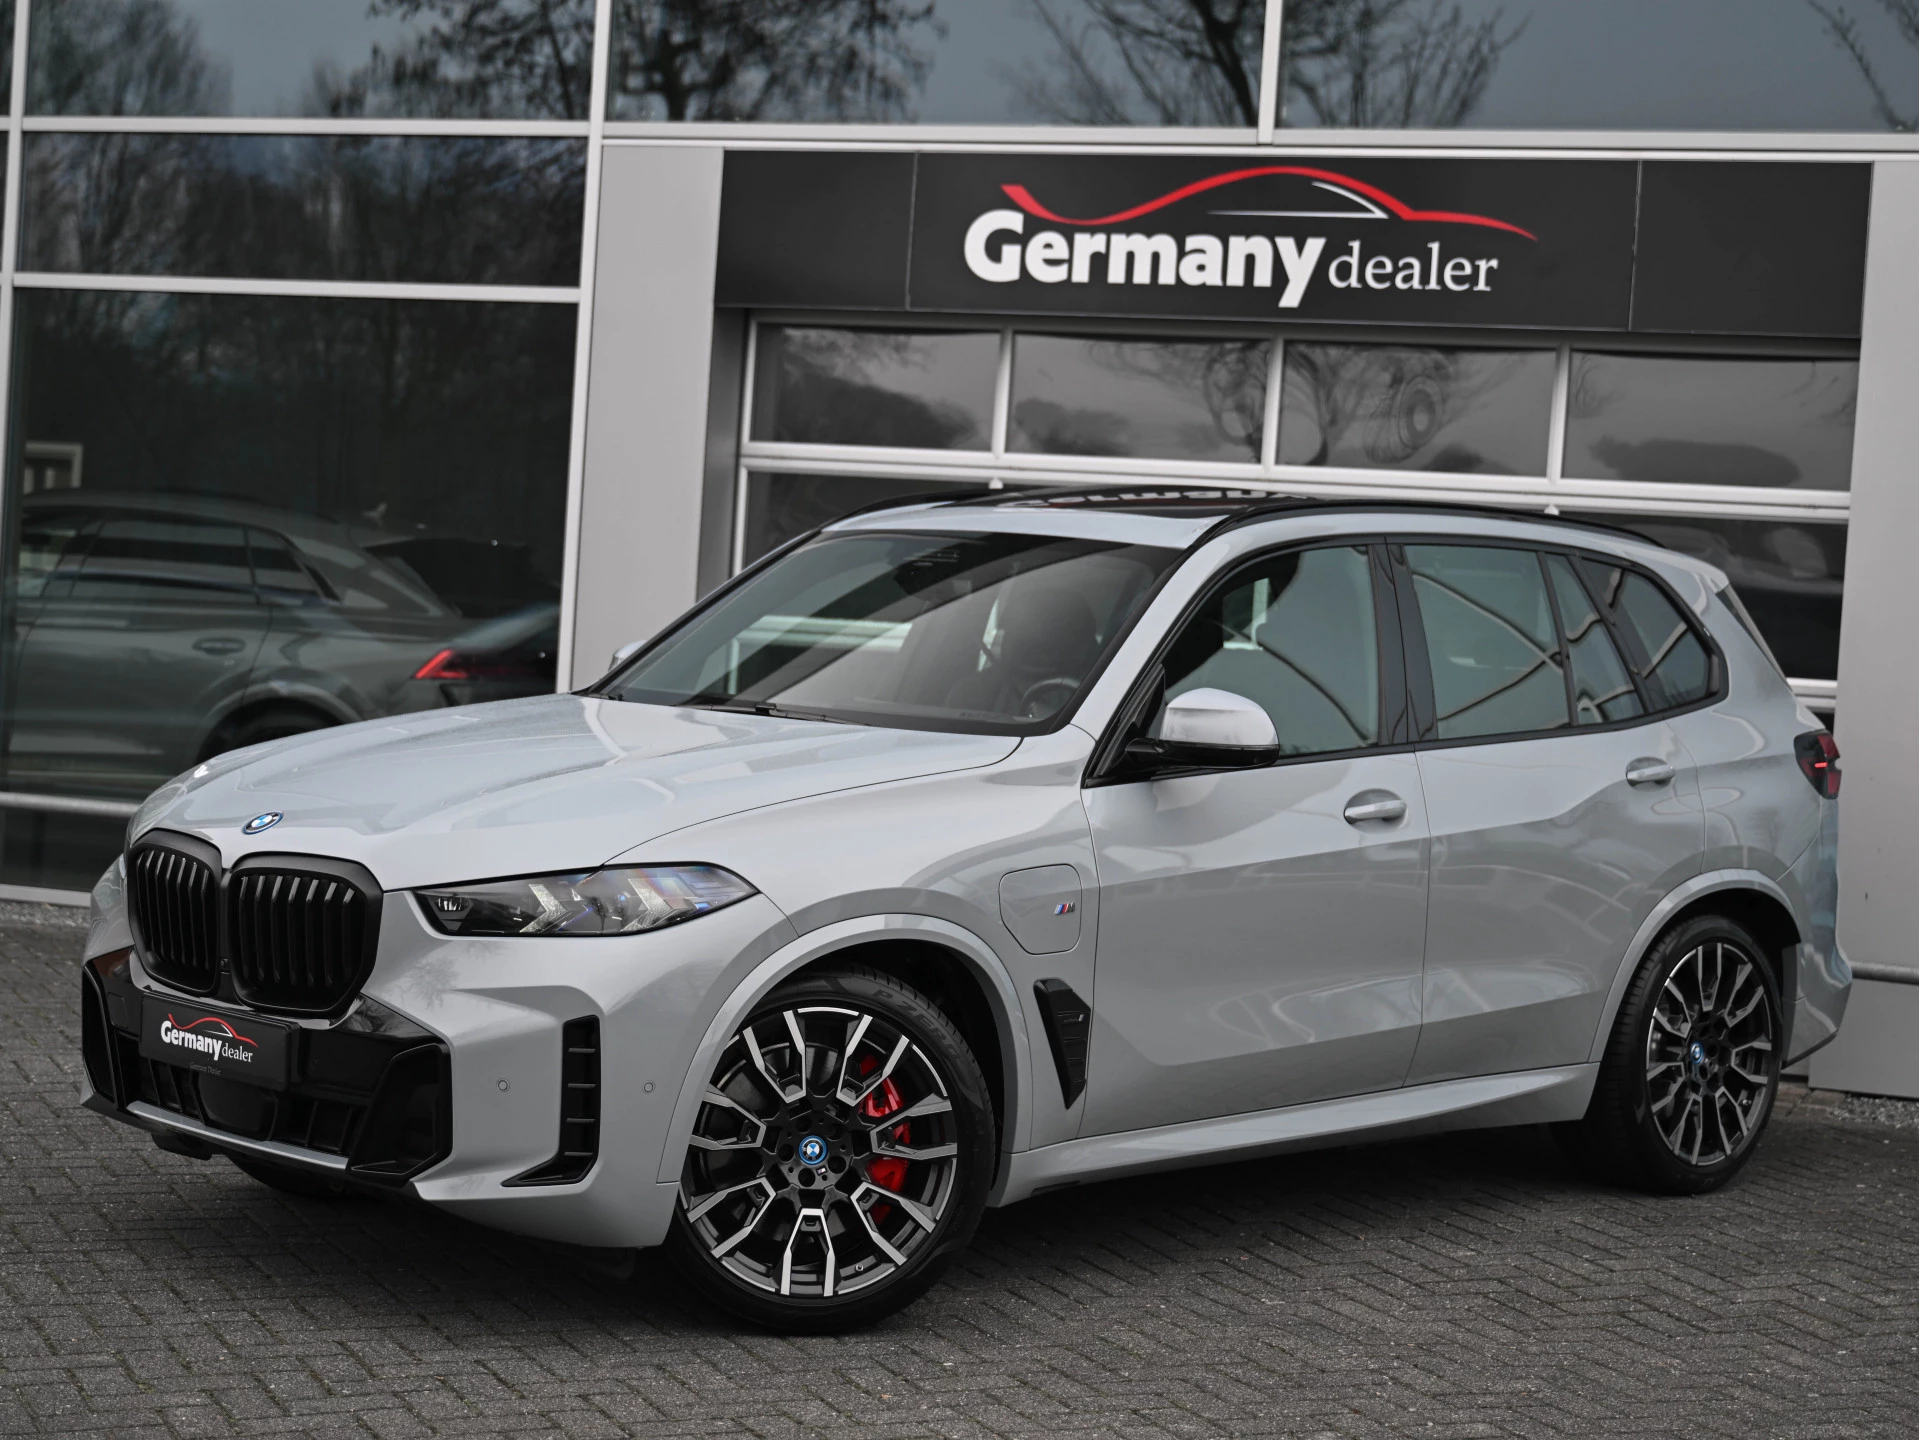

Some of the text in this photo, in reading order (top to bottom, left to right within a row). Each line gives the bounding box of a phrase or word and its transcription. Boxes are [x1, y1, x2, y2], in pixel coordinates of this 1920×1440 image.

[964, 209, 1498, 308] Germany dealer
[161, 1020, 253, 1063] Germany dealer
